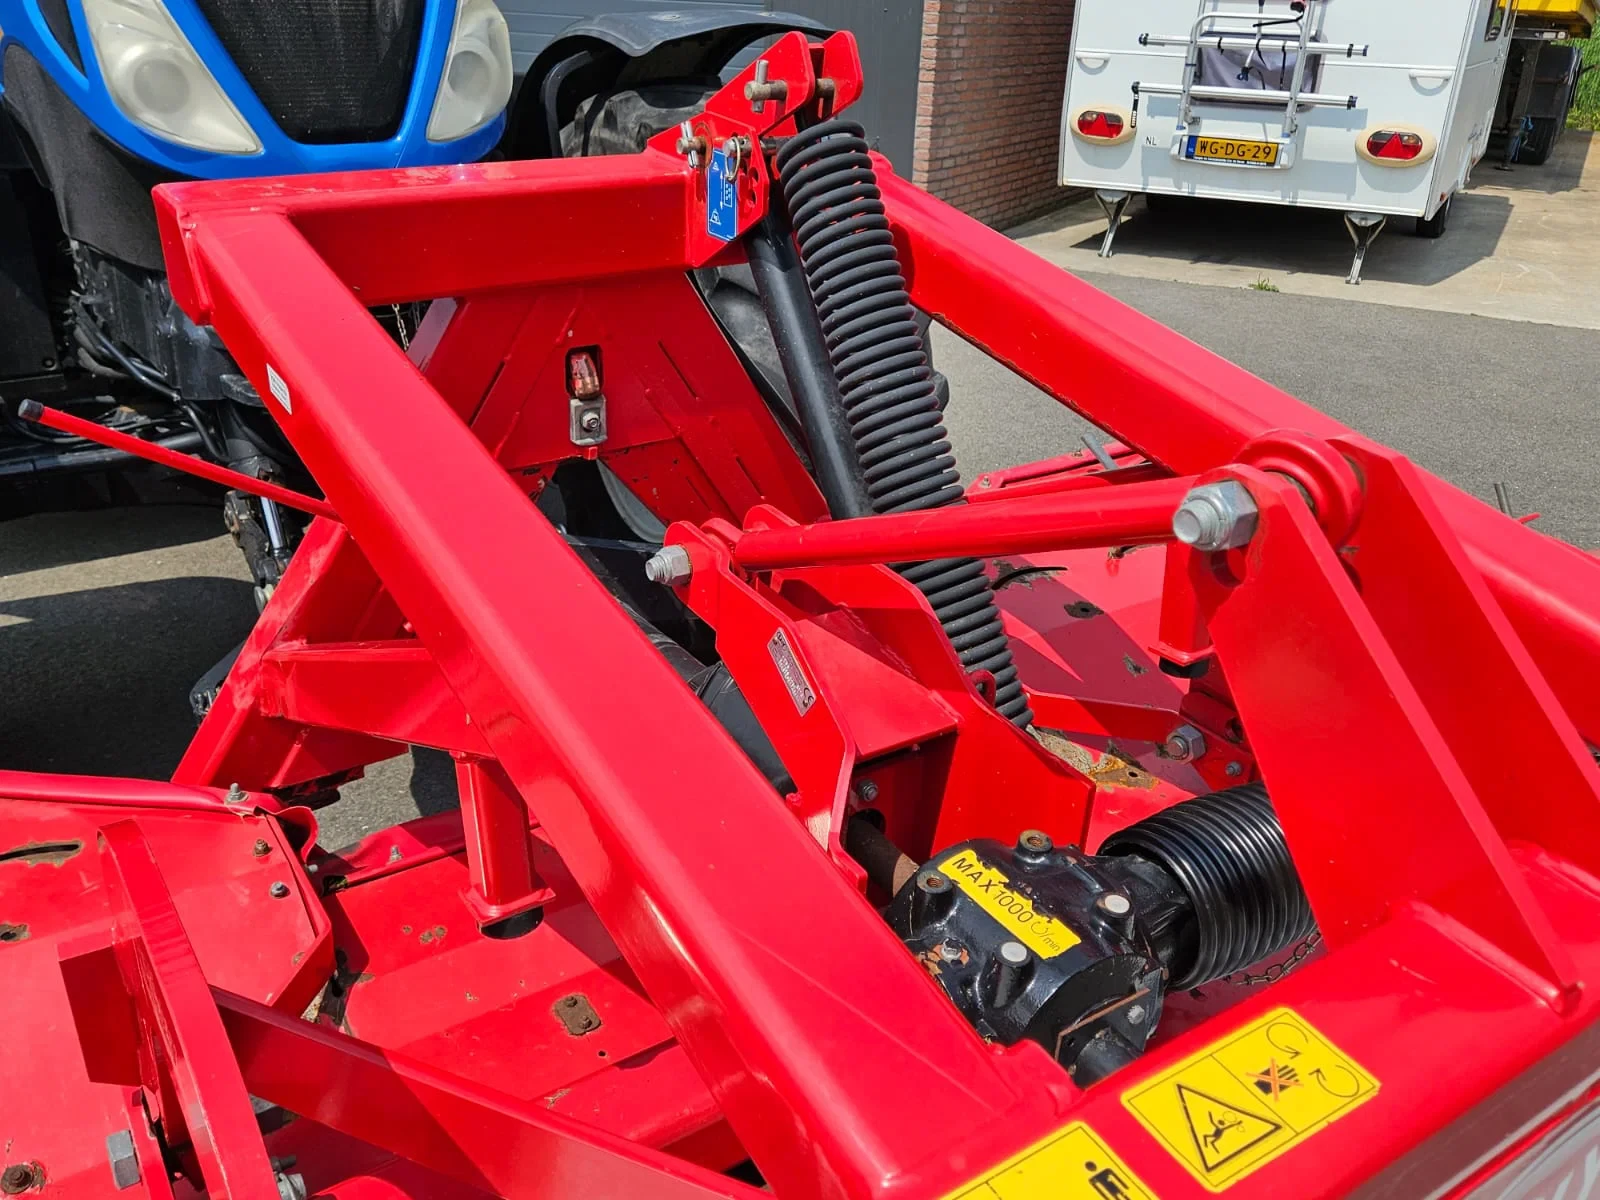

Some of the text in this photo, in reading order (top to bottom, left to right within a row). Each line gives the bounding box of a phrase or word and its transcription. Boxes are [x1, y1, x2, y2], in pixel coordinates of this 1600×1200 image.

[1145, 136, 1157, 146] NL
[1200, 140, 1272, 160] WG-DG-29
[952, 857, 998, 893] MAX
[993, 890, 1034, 923] 1000
